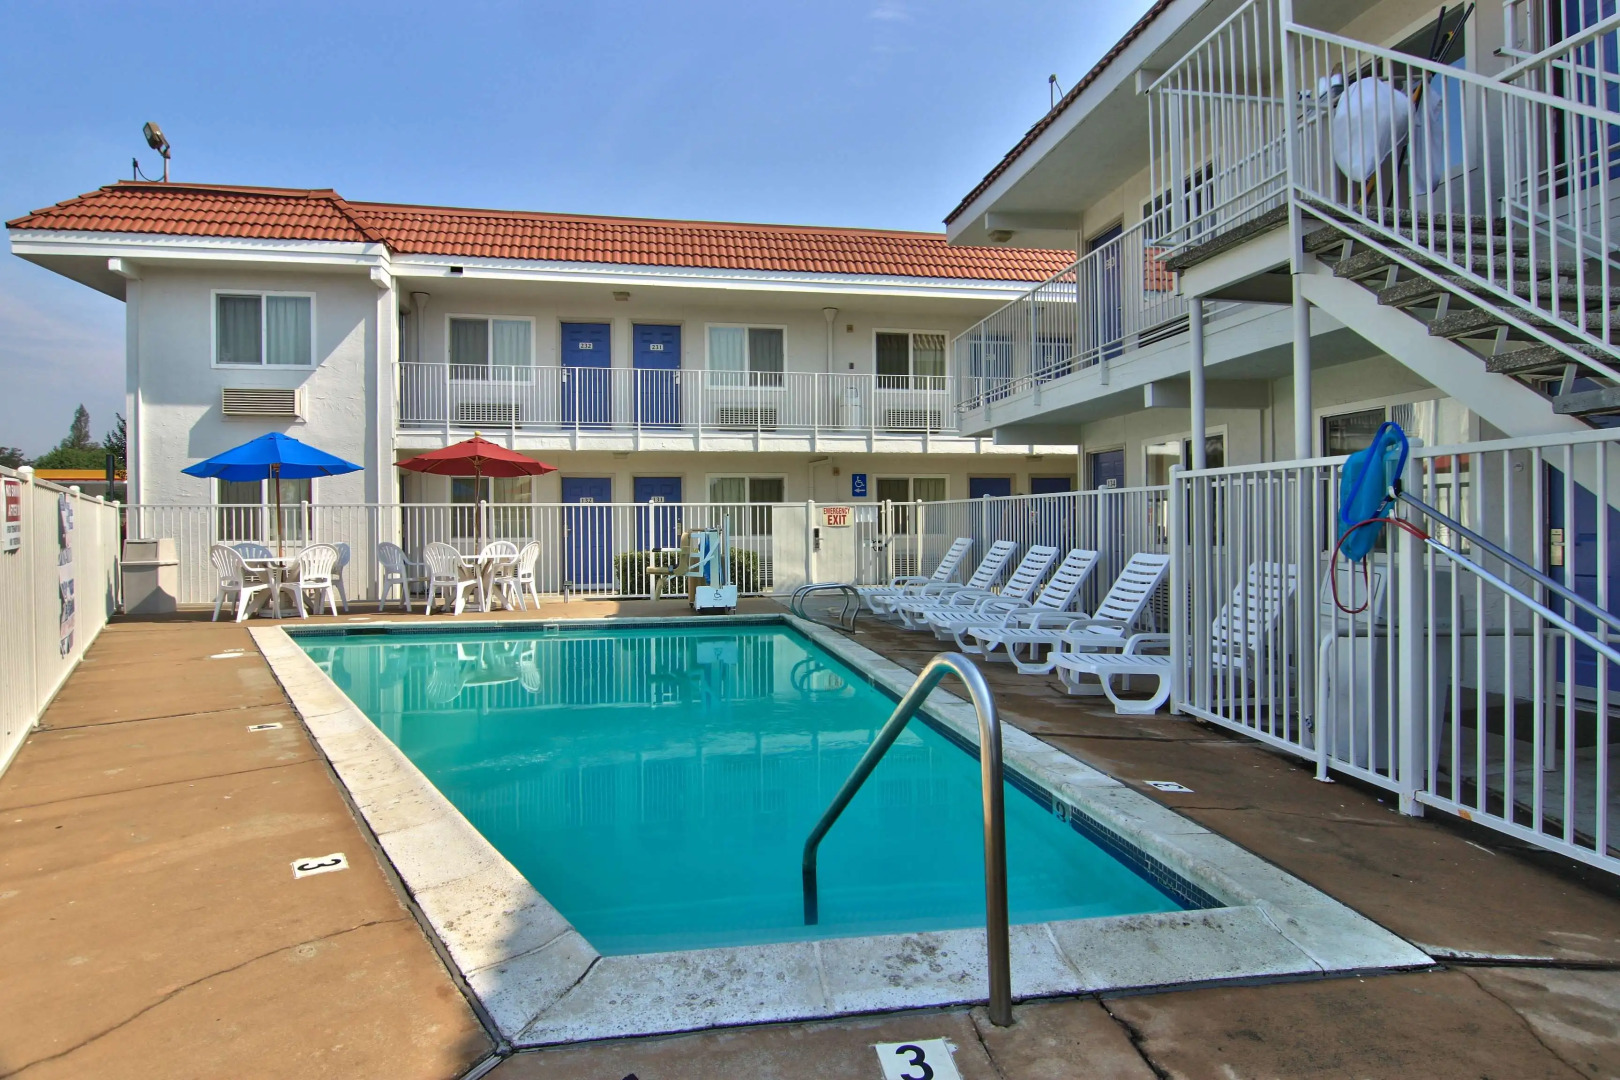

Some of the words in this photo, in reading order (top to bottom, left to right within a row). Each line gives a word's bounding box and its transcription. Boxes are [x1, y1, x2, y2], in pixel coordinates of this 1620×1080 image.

[823, 507, 850, 515] EMERGENCY
[827, 515, 847, 526] EXIT
[297, 858, 342, 872] 3
[895, 1044, 934, 1080] 3
